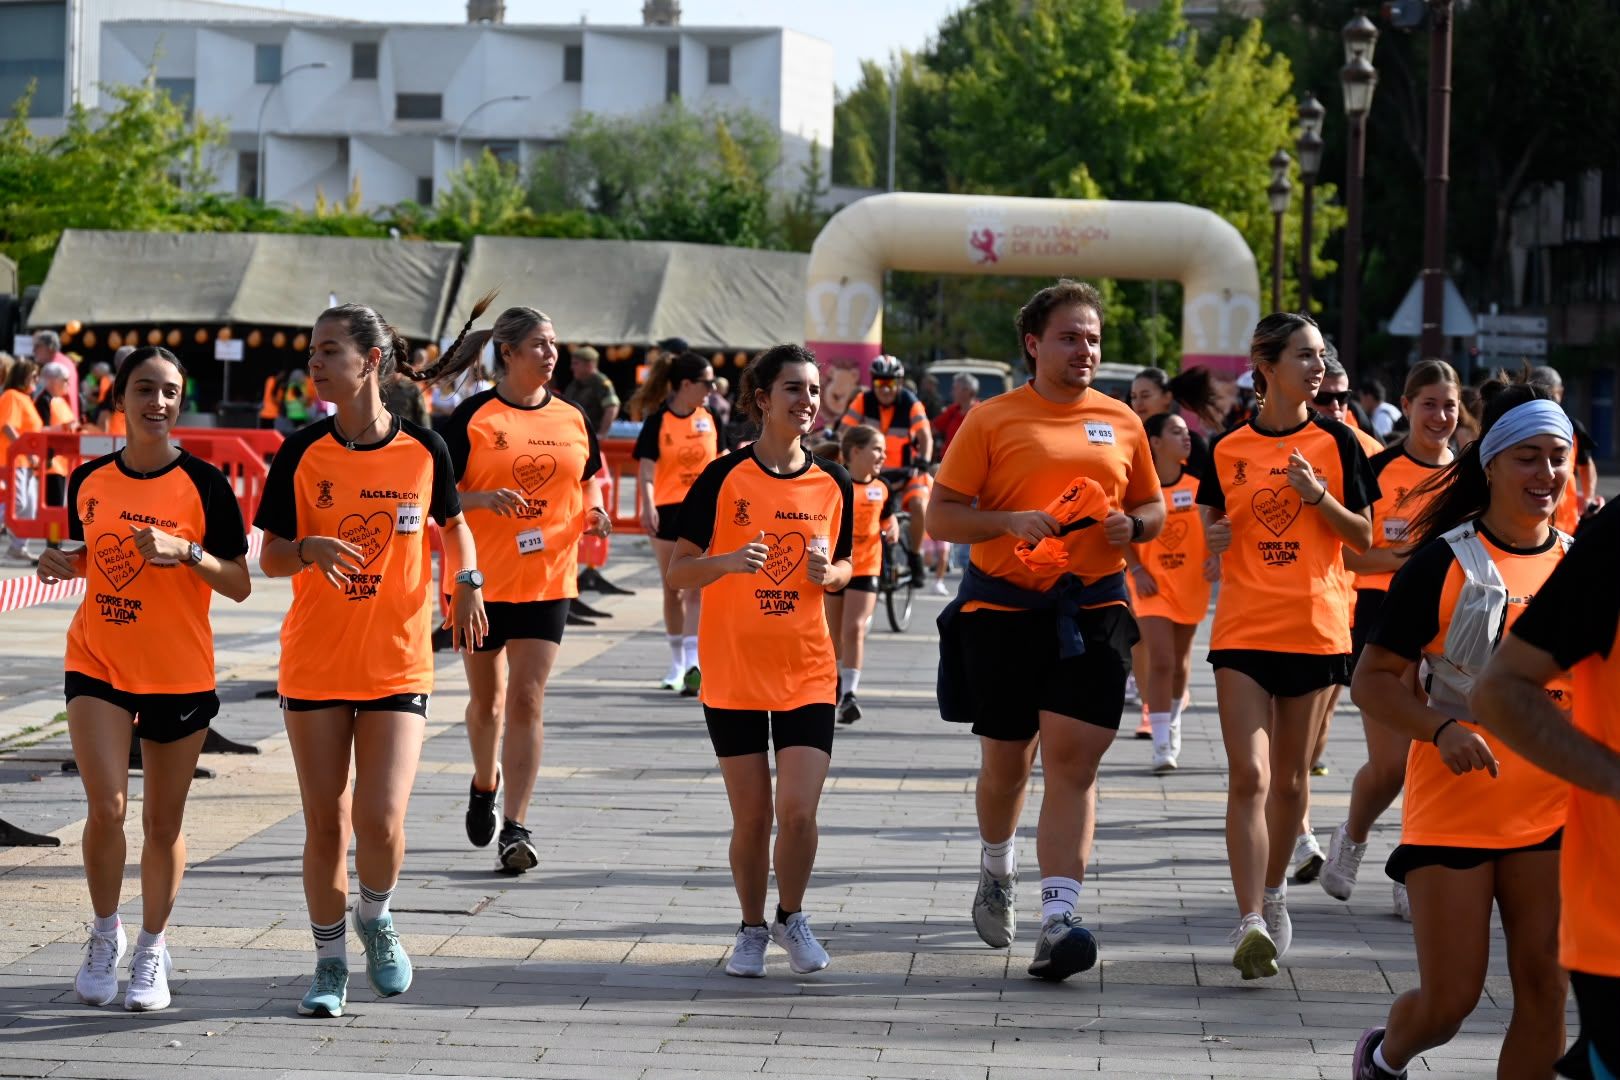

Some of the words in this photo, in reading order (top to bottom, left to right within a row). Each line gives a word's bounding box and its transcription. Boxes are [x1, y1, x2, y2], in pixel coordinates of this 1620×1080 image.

[534, 499, 548, 508] POR
[529, 538, 542, 546] 313
[1258, 541, 1283, 550] CORRE
[1284, 542, 1300, 552] POR
[1263, 550, 1275, 561] LA
[344, 584, 358, 595] LA
[755, 588, 782, 599] CORRE
[784, 590, 800, 600] POR
[96, 592, 122, 607] CORRE
[124, 598, 142, 611] POR
[760, 600, 772, 610] LA
[101, 604, 112, 618] LA
